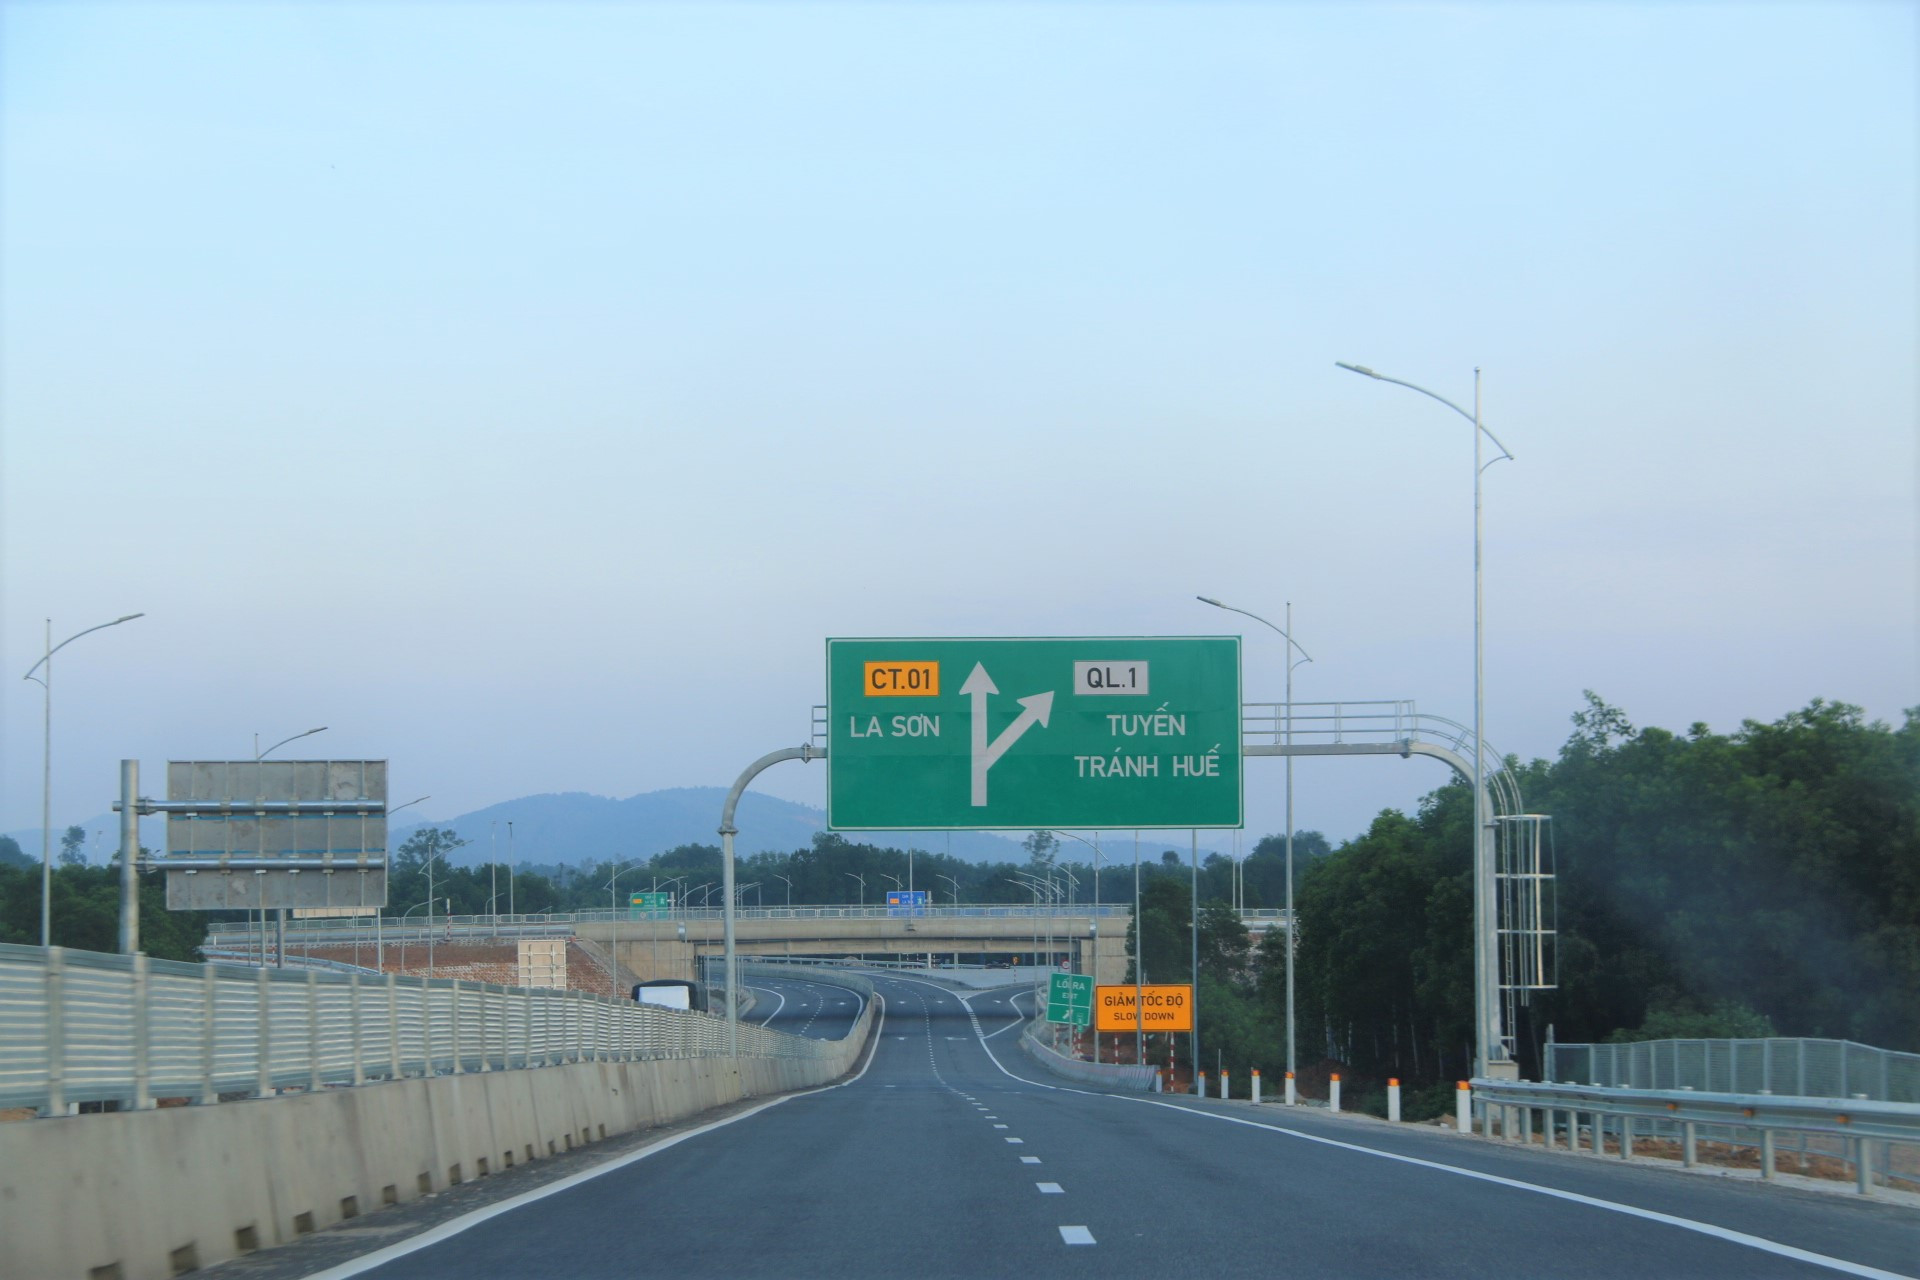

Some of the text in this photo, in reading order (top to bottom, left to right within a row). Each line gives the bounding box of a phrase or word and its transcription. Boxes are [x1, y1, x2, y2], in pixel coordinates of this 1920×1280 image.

[871, 668, 931, 690] CT.01
[1086, 667, 1137, 688] QL.1
[850, 713, 940, 738] LA SƠN
[1106, 701, 1186, 736] TUYẾN
[1074, 743, 1222, 778] TRÁNH HUẾ
[1073, 981, 1085, 991] RA
[1104, 991, 1184, 1008] GIẢM TỐC ĐỘ
[1144, 1012, 1175, 1020] DOWN
